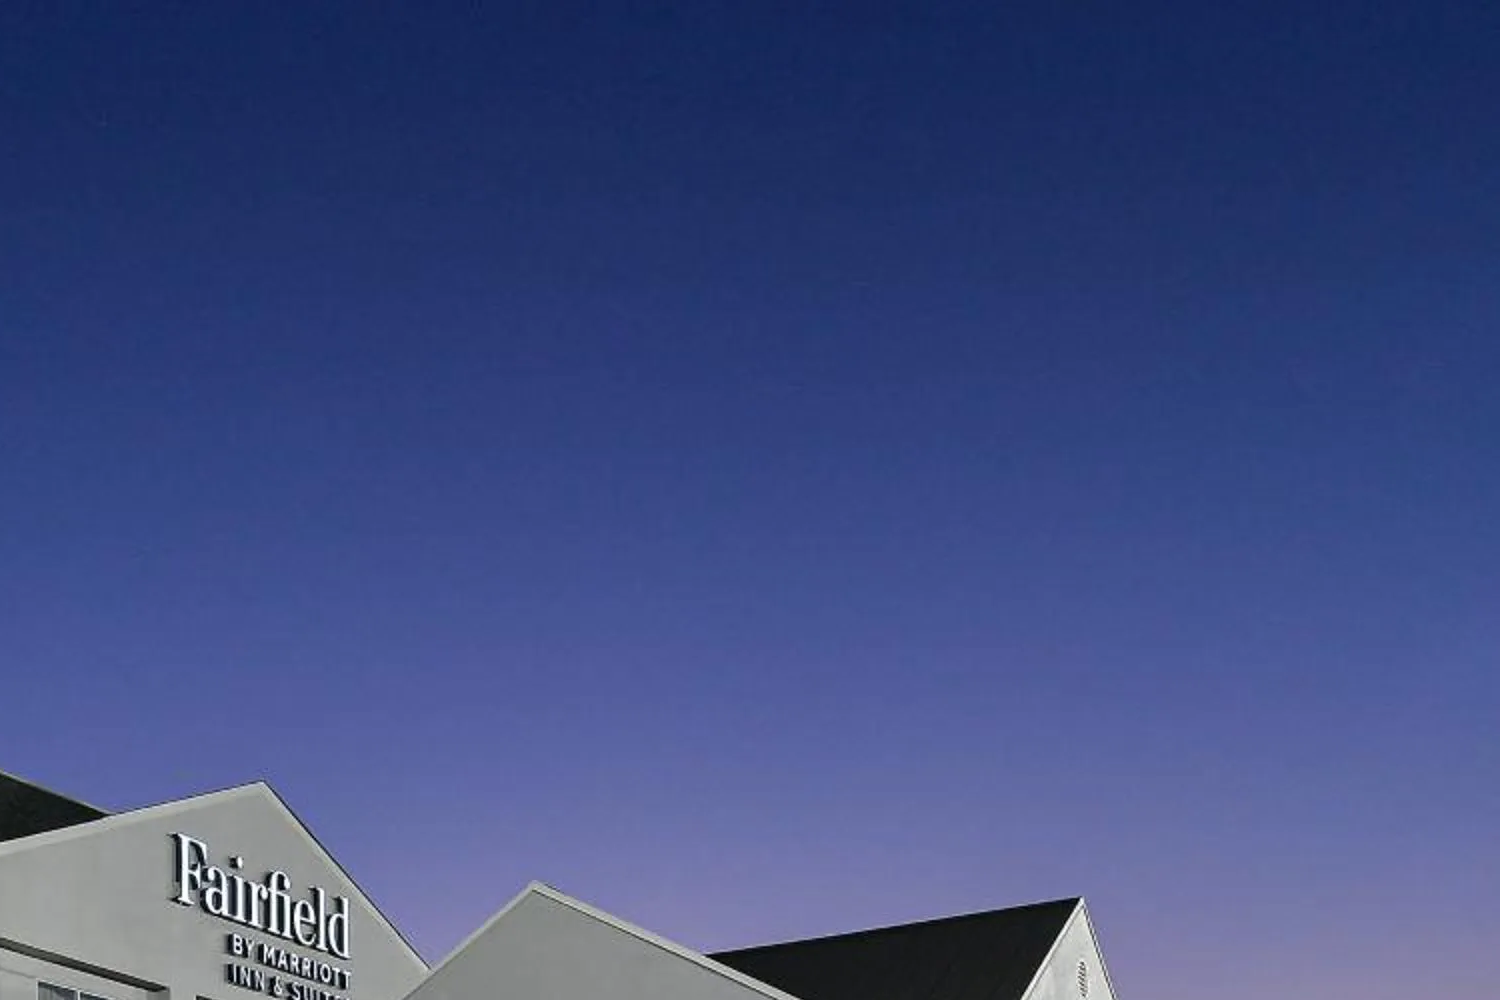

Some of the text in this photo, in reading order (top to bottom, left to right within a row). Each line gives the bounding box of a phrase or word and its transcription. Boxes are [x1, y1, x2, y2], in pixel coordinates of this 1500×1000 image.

[170, 832, 351, 960] Fairfield
[227, 963, 266, 993] INN
[270, 975, 284, 998] &
[228, 933, 352, 991] BY MARRIOTT
